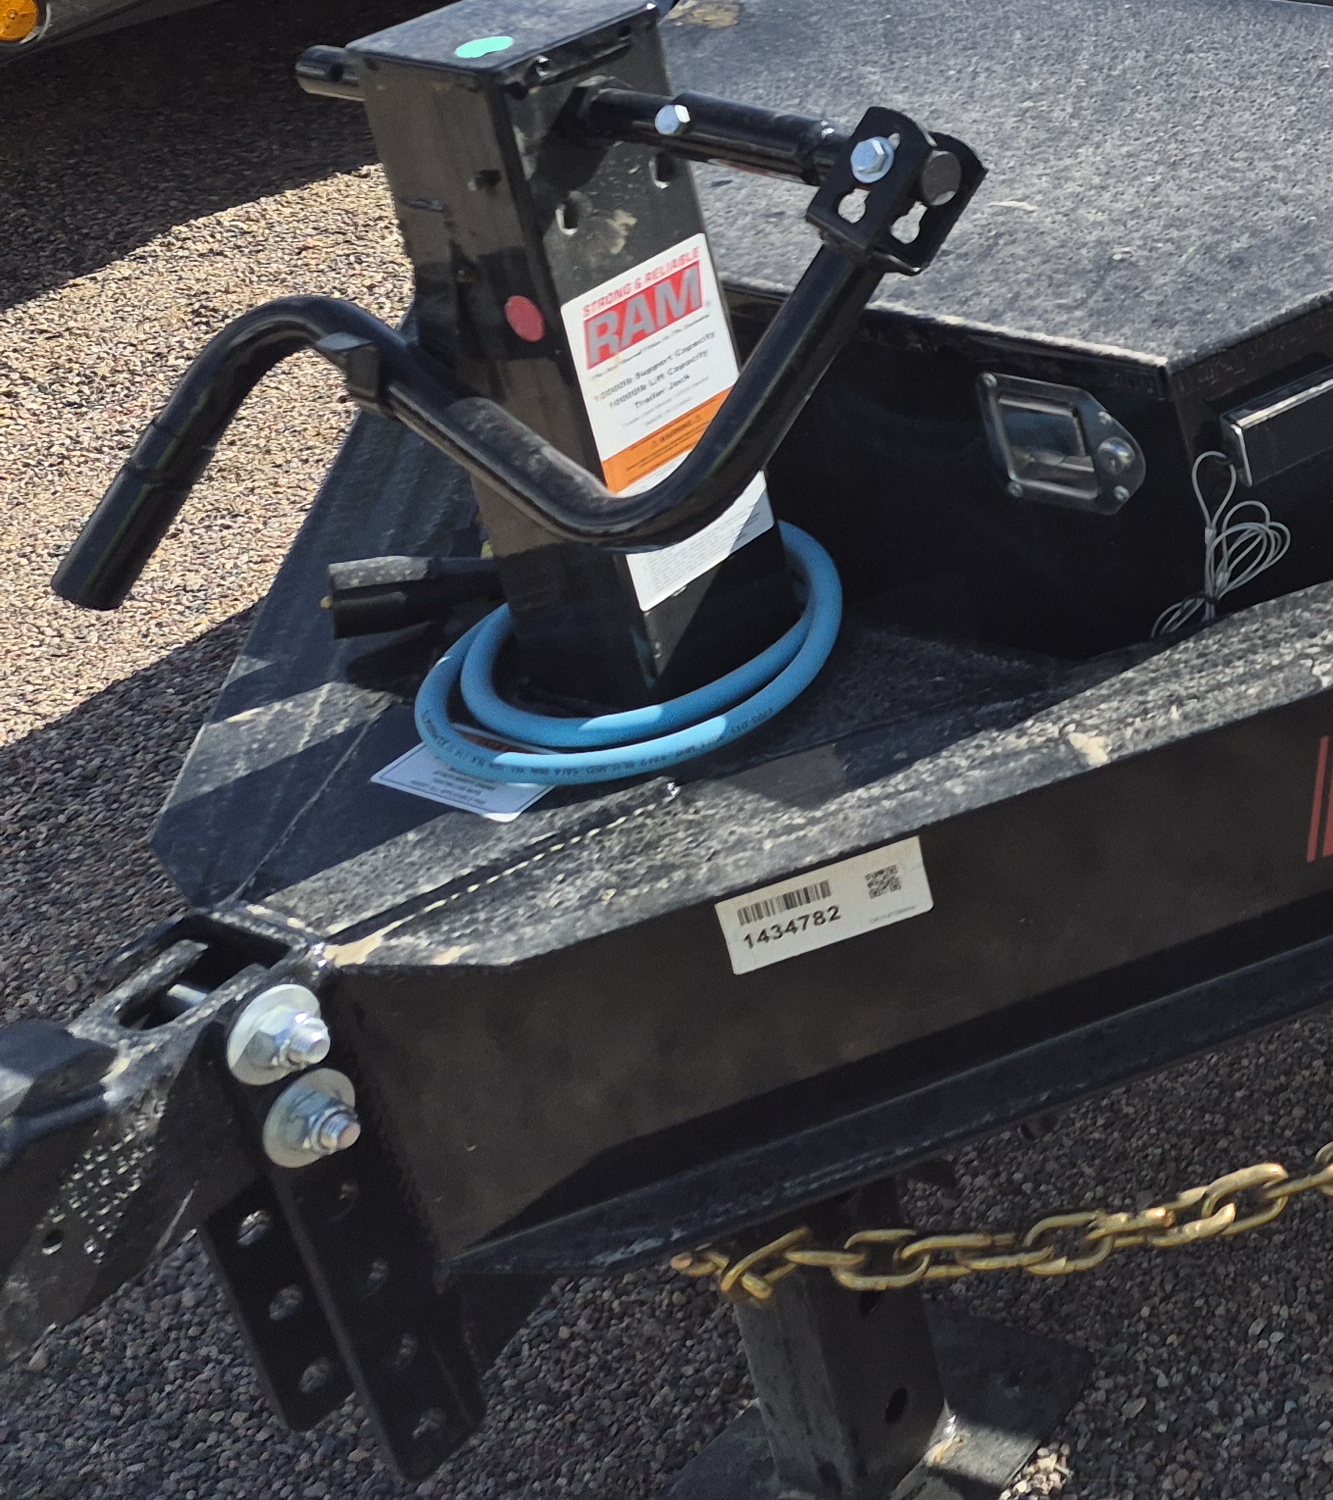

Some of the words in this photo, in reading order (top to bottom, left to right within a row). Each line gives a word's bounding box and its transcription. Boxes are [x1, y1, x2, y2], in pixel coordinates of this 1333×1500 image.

[583, 283, 631, 316] STRONG
[588, 264, 702, 365] RAM
[743, 905, 842, 950] 1434782
